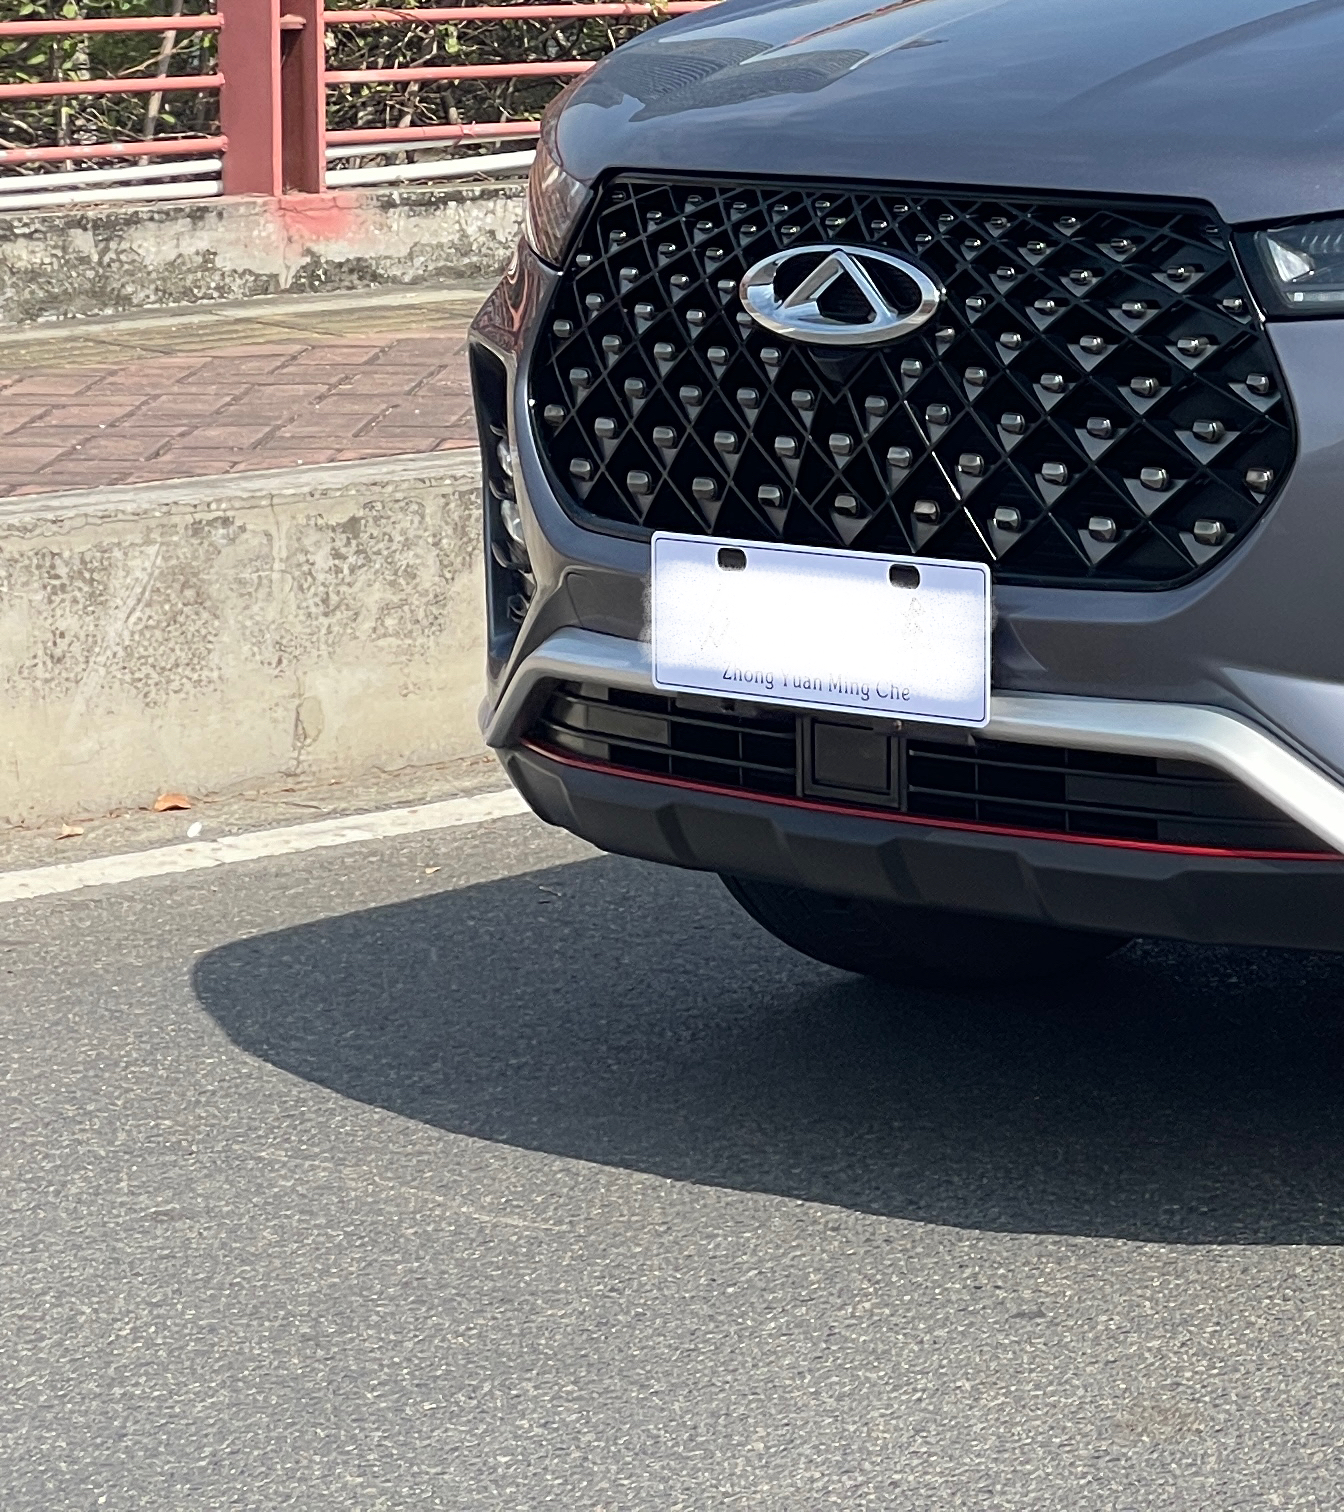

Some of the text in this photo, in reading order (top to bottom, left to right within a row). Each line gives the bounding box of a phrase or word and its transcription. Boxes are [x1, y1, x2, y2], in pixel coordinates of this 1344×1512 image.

[720, 662, 912, 702] Zhong Yuan Ming Che
